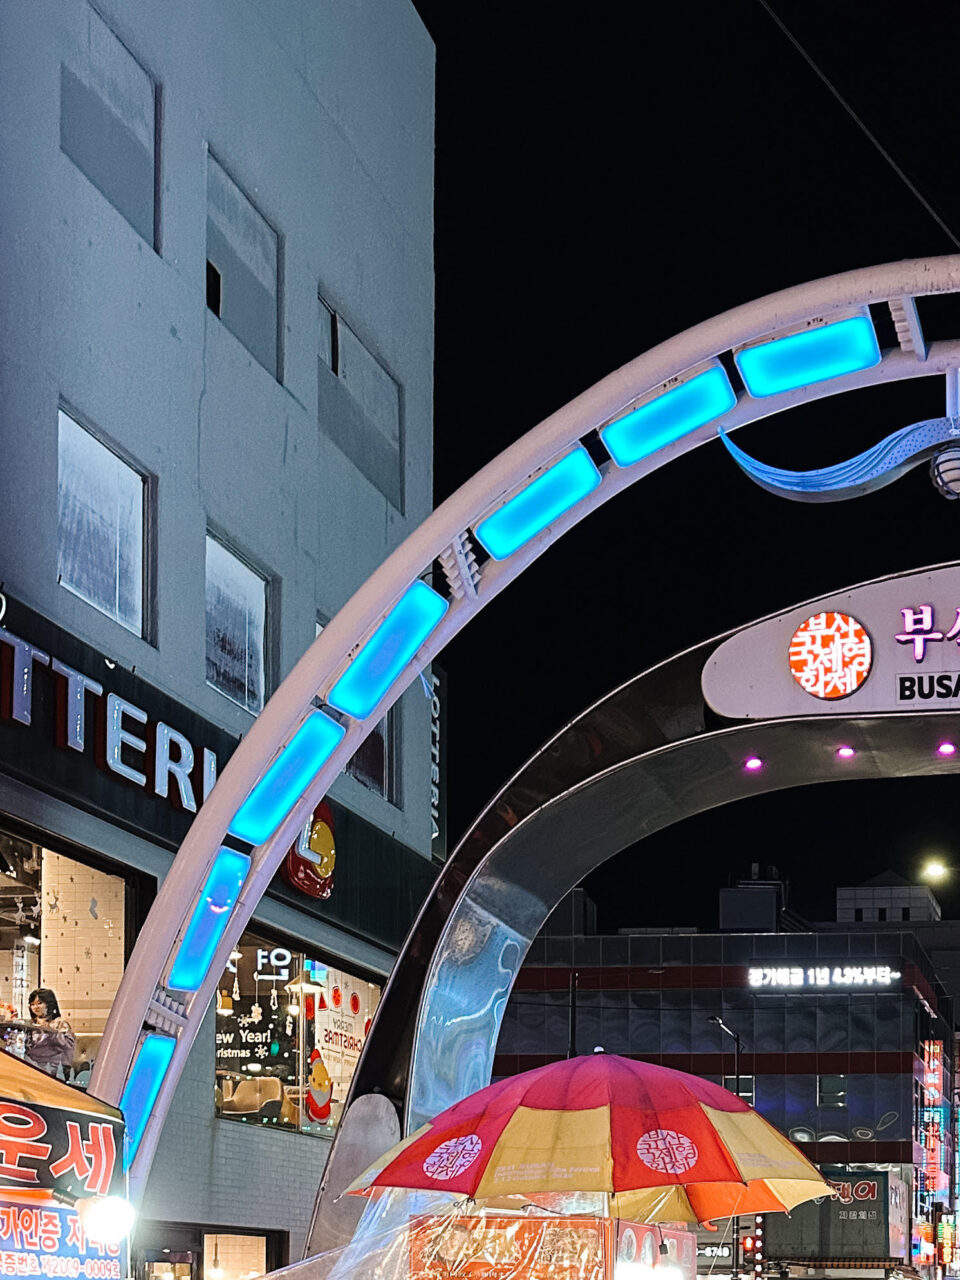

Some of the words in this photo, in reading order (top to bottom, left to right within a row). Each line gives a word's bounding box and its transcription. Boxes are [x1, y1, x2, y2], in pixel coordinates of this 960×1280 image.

[431, 673, 441, 841] LOTTERIA
[240, 1030, 271, 1043] Year!
[0, 1103, 115, 1197] 운세
